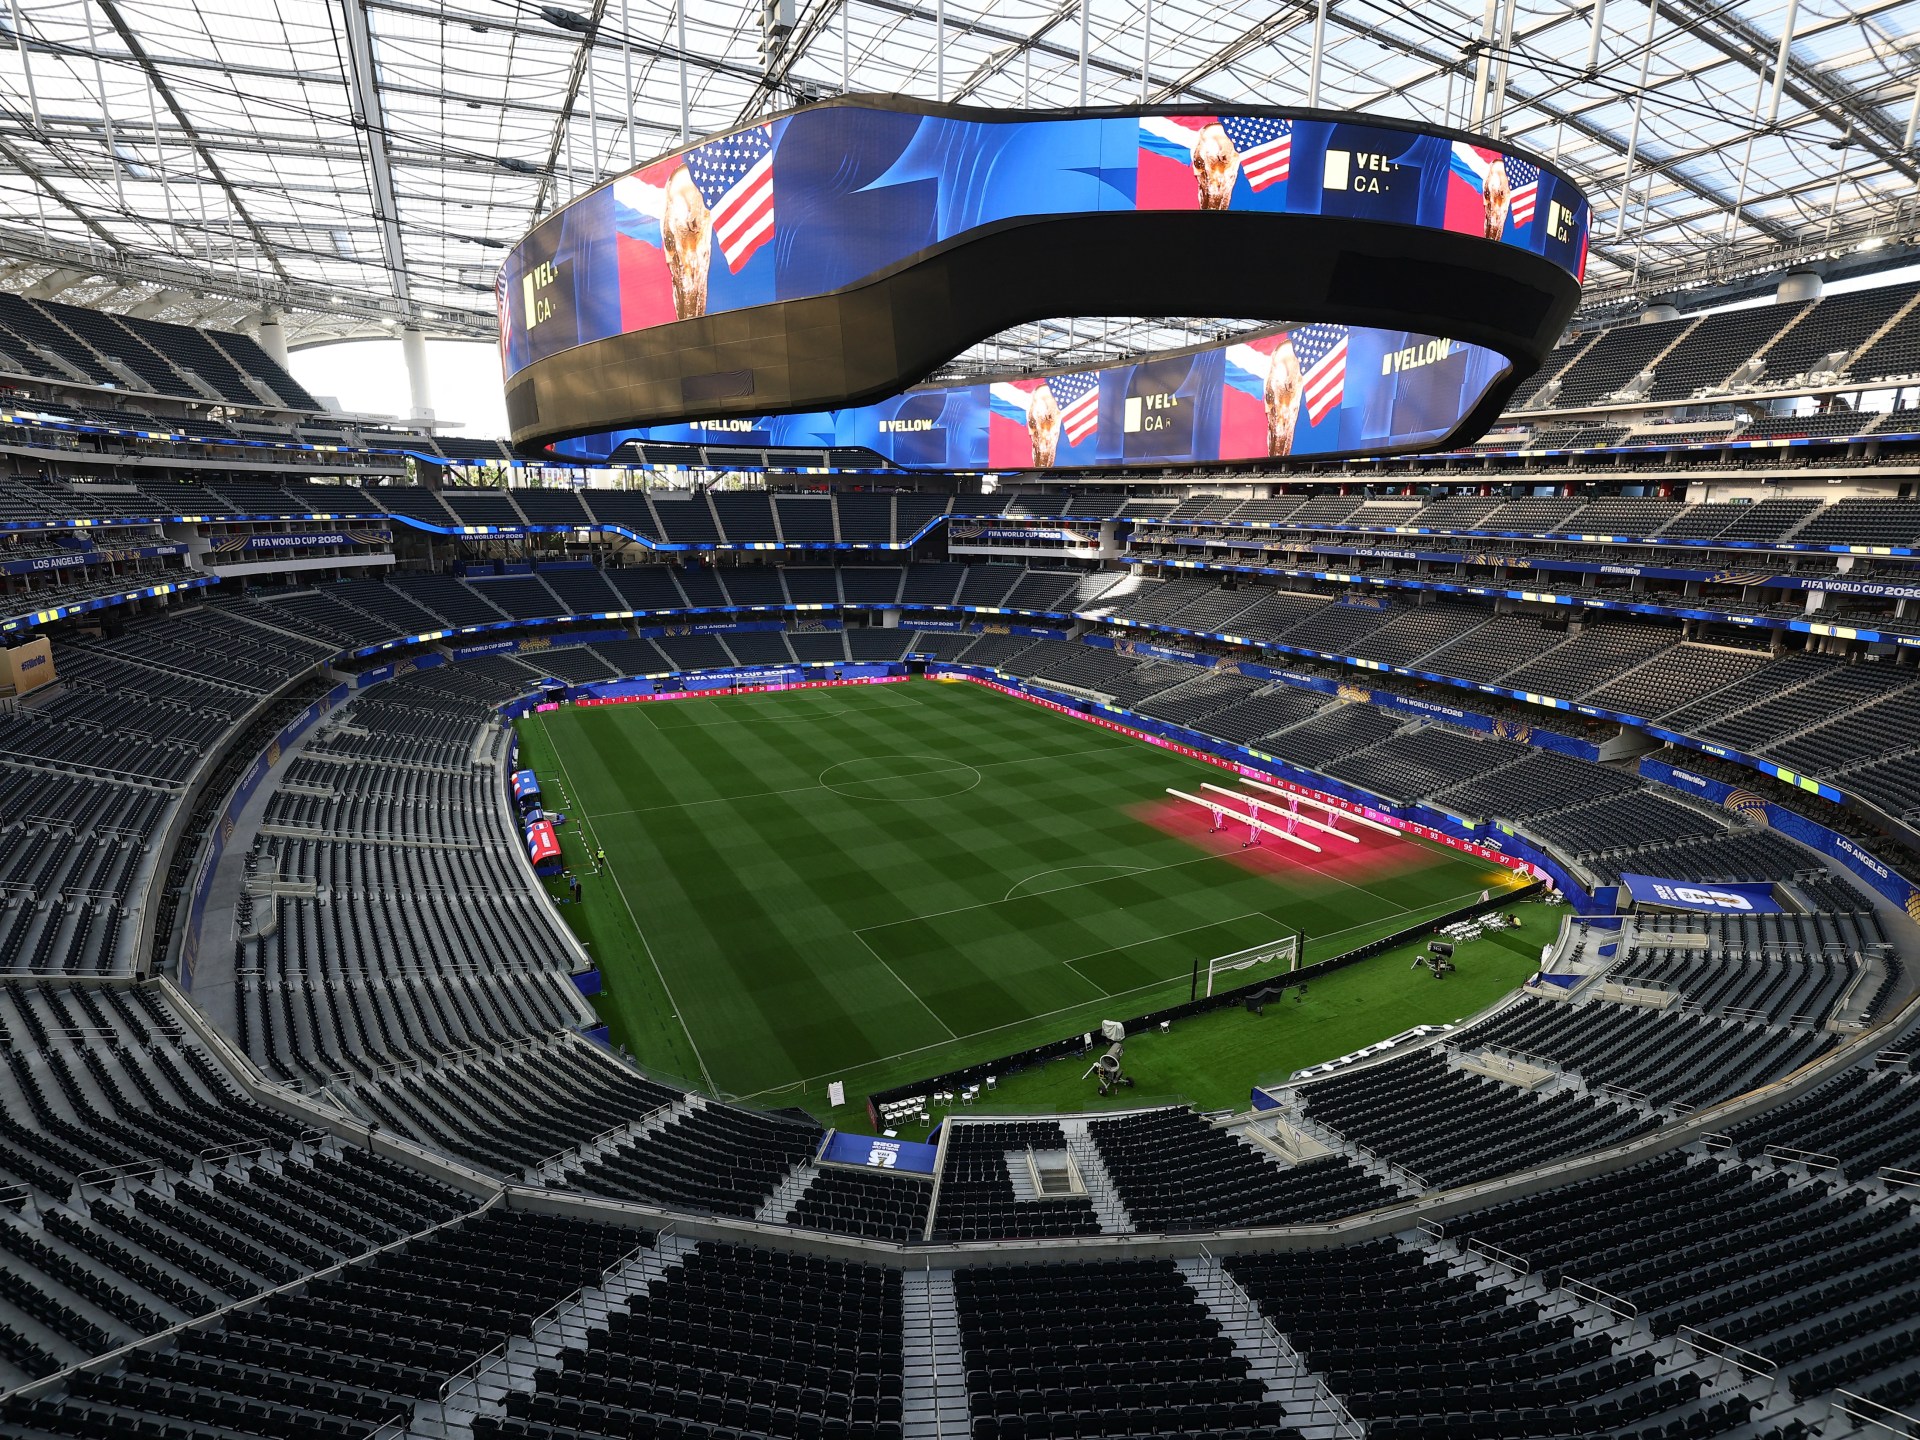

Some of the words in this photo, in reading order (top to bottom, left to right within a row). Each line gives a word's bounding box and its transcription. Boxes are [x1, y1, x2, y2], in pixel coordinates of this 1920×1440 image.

[1354, 176, 1389, 193] CA
[1558, 227, 1569, 243] CA
[537, 297, 556, 323] CA
[1394, 338, 1450, 373] YELLOW
[701, 420, 752, 432] YELLOW
[888, 419, 932, 432] YELLOW
[252, 538, 270, 547] FIFA
[271, 537, 300, 546] WORLD
[301, 537, 317, 545] CUP
[318, 535, 343, 544] 2026
[1376, 550, 1416, 559] ANGELES
[33, 559, 50, 570] LOS
[51, 556, 84, 568] ANGELES
[1600, 566, 1641, 576] #FIFAWorldCup
[1801, 580, 1824, 590] FIFA
[1825, 581, 1861, 593] WORLD
[1862, 584, 1884, 594] CUP
[1884, 586, 1920, 598] 2026
[686, 674, 706, 682] FIFA
[707, 672, 743, 680] WORLD
[744, 670, 762, 678] CUP
[762, 668, 796, 676] 2026
[1282, 671, 1311, 683] ANGELES
[1395, 696, 1409, 705] FIFA
[1408, 699, 1429, 711] WORLD
[1429, 704, 1442, 713] CUP
[1442, 707, 1463, 718] 2026
[1705, 745, 1725, 756] YELLOW
[1301, 788, 1309, 796] 84
[1314, 792, 1321, 800] 85
[1327, 796, 1335, 805] 86
[1340, 801, 1349, 809] 87
[1353, 805, 1362, 814] 88
[1378, 803, 1391, 813] FIFA
[1368, 811, 1377, 819] 89
[1383, 816, 1392, 824] 90
[1399, 821, 1406, 829] 91
[1413, 826, 1422, 835] 92
[1429, 831, 1439, 840] 93
[1446, 837, 1456, 846] 94
[1463, 843, 1473, 852] 95
[1481, 849, 1491, 858] 96
[1836, 837, 1852, 853] LOS
[1852, 849, 1888, 879] ANGELES
[1499, 855, 1510, 864] 97
[1518, 861, 1529, 871] 98
